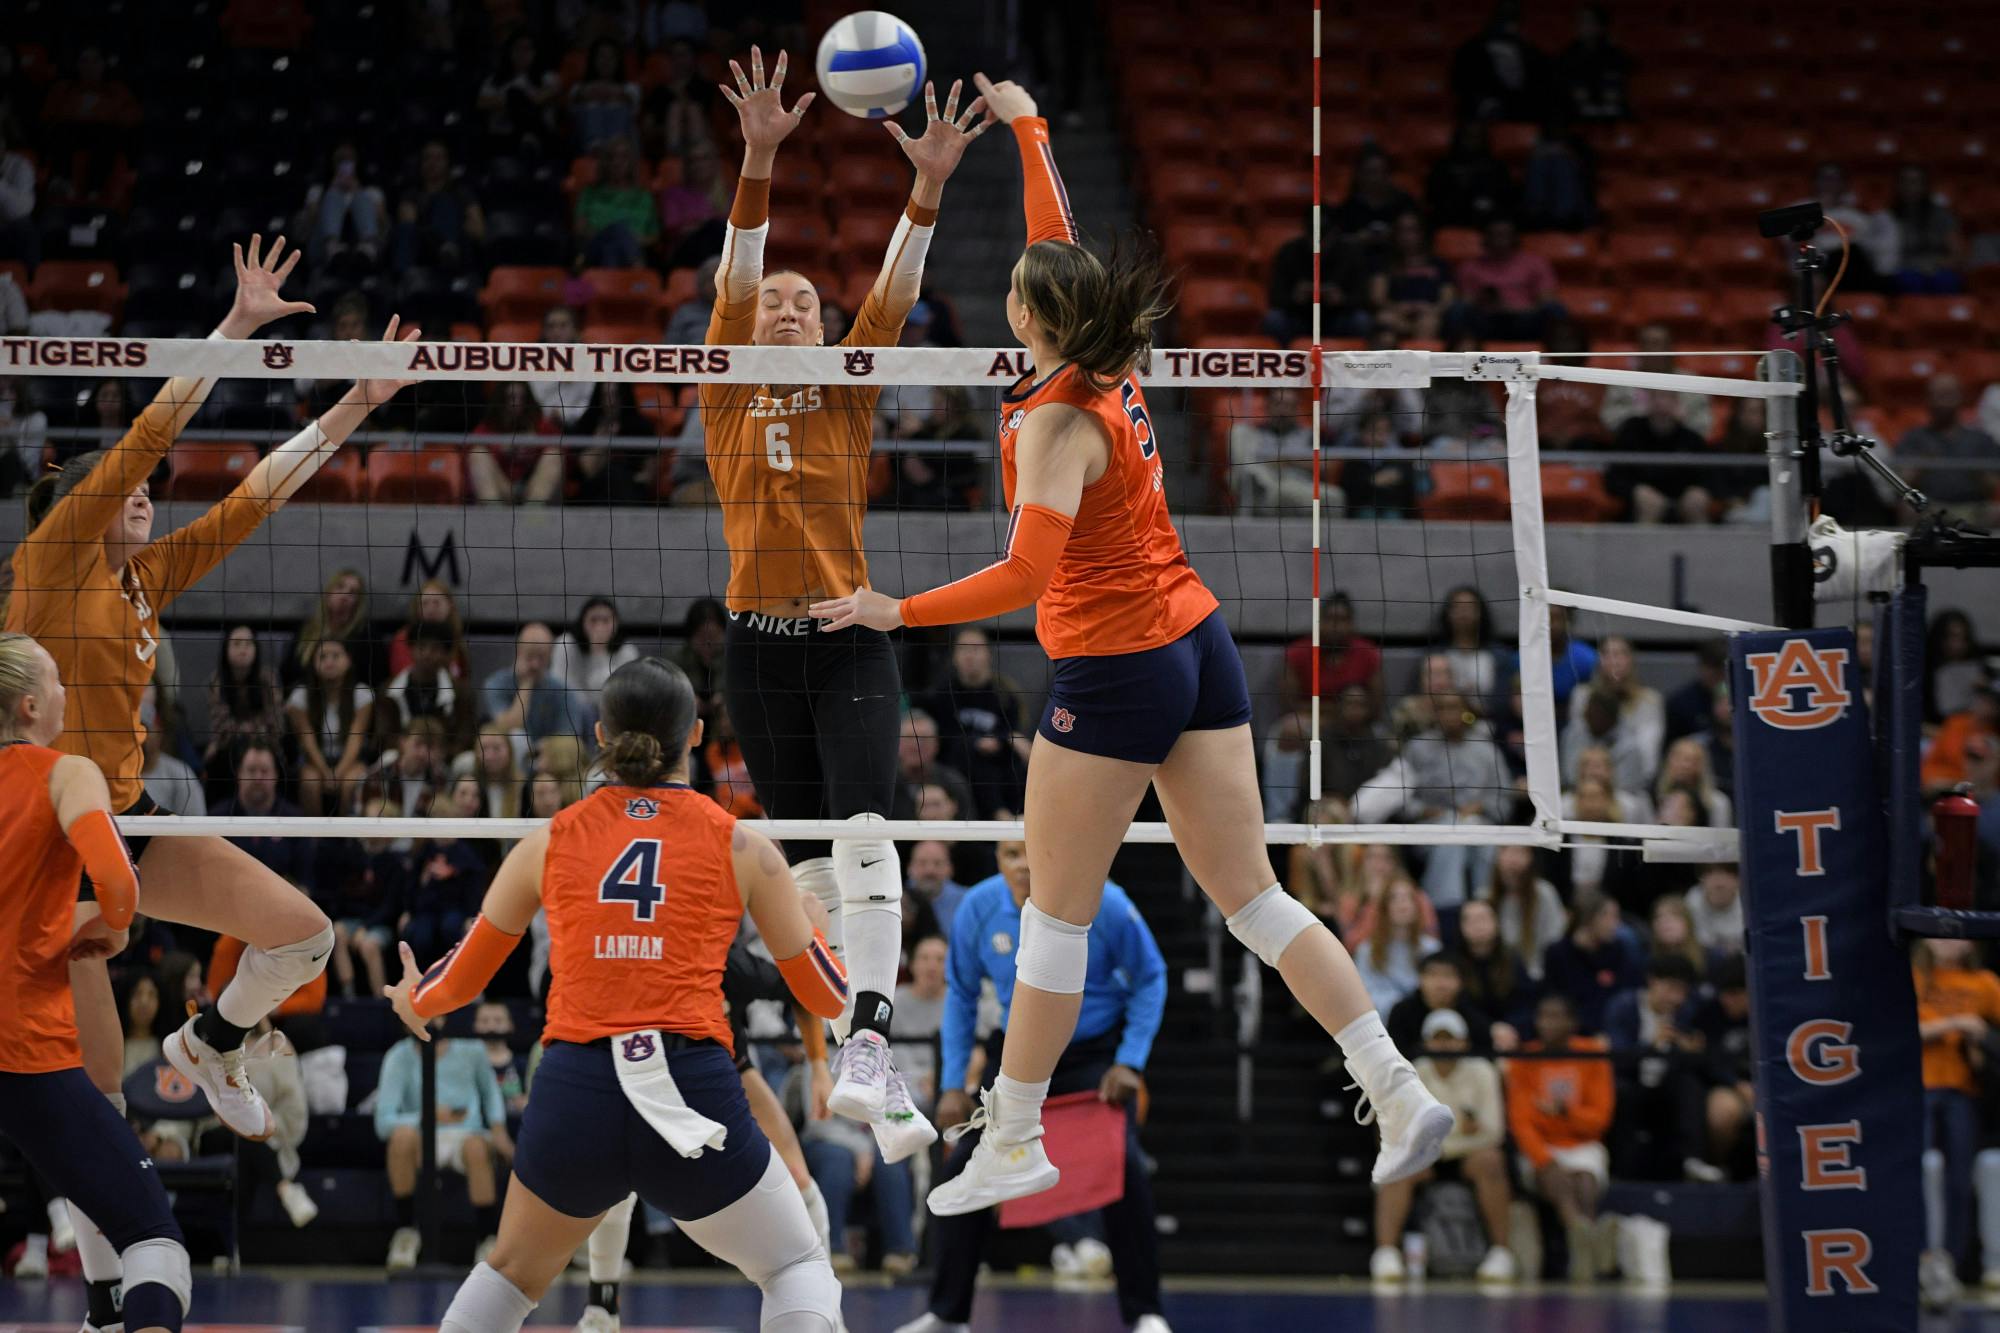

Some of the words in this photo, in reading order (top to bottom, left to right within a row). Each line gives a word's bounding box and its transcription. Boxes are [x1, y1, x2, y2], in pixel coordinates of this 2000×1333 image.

[3, 340, 149, 368] TIGERS
[407, 345, 575, 372] AUBURN
[587, 347, 732, 375] TIGERS
[1165, 351, 1307, 378] TIGERS
[1121, 378, 1156, 461] 5
[765, 422, 794, 472] 6
[401, 529, 462, 586] M
[747, 611, 811, 636] NIKE
[597, 837, 667, 922] 4
[593, 935, 664, 960] LANHAM
